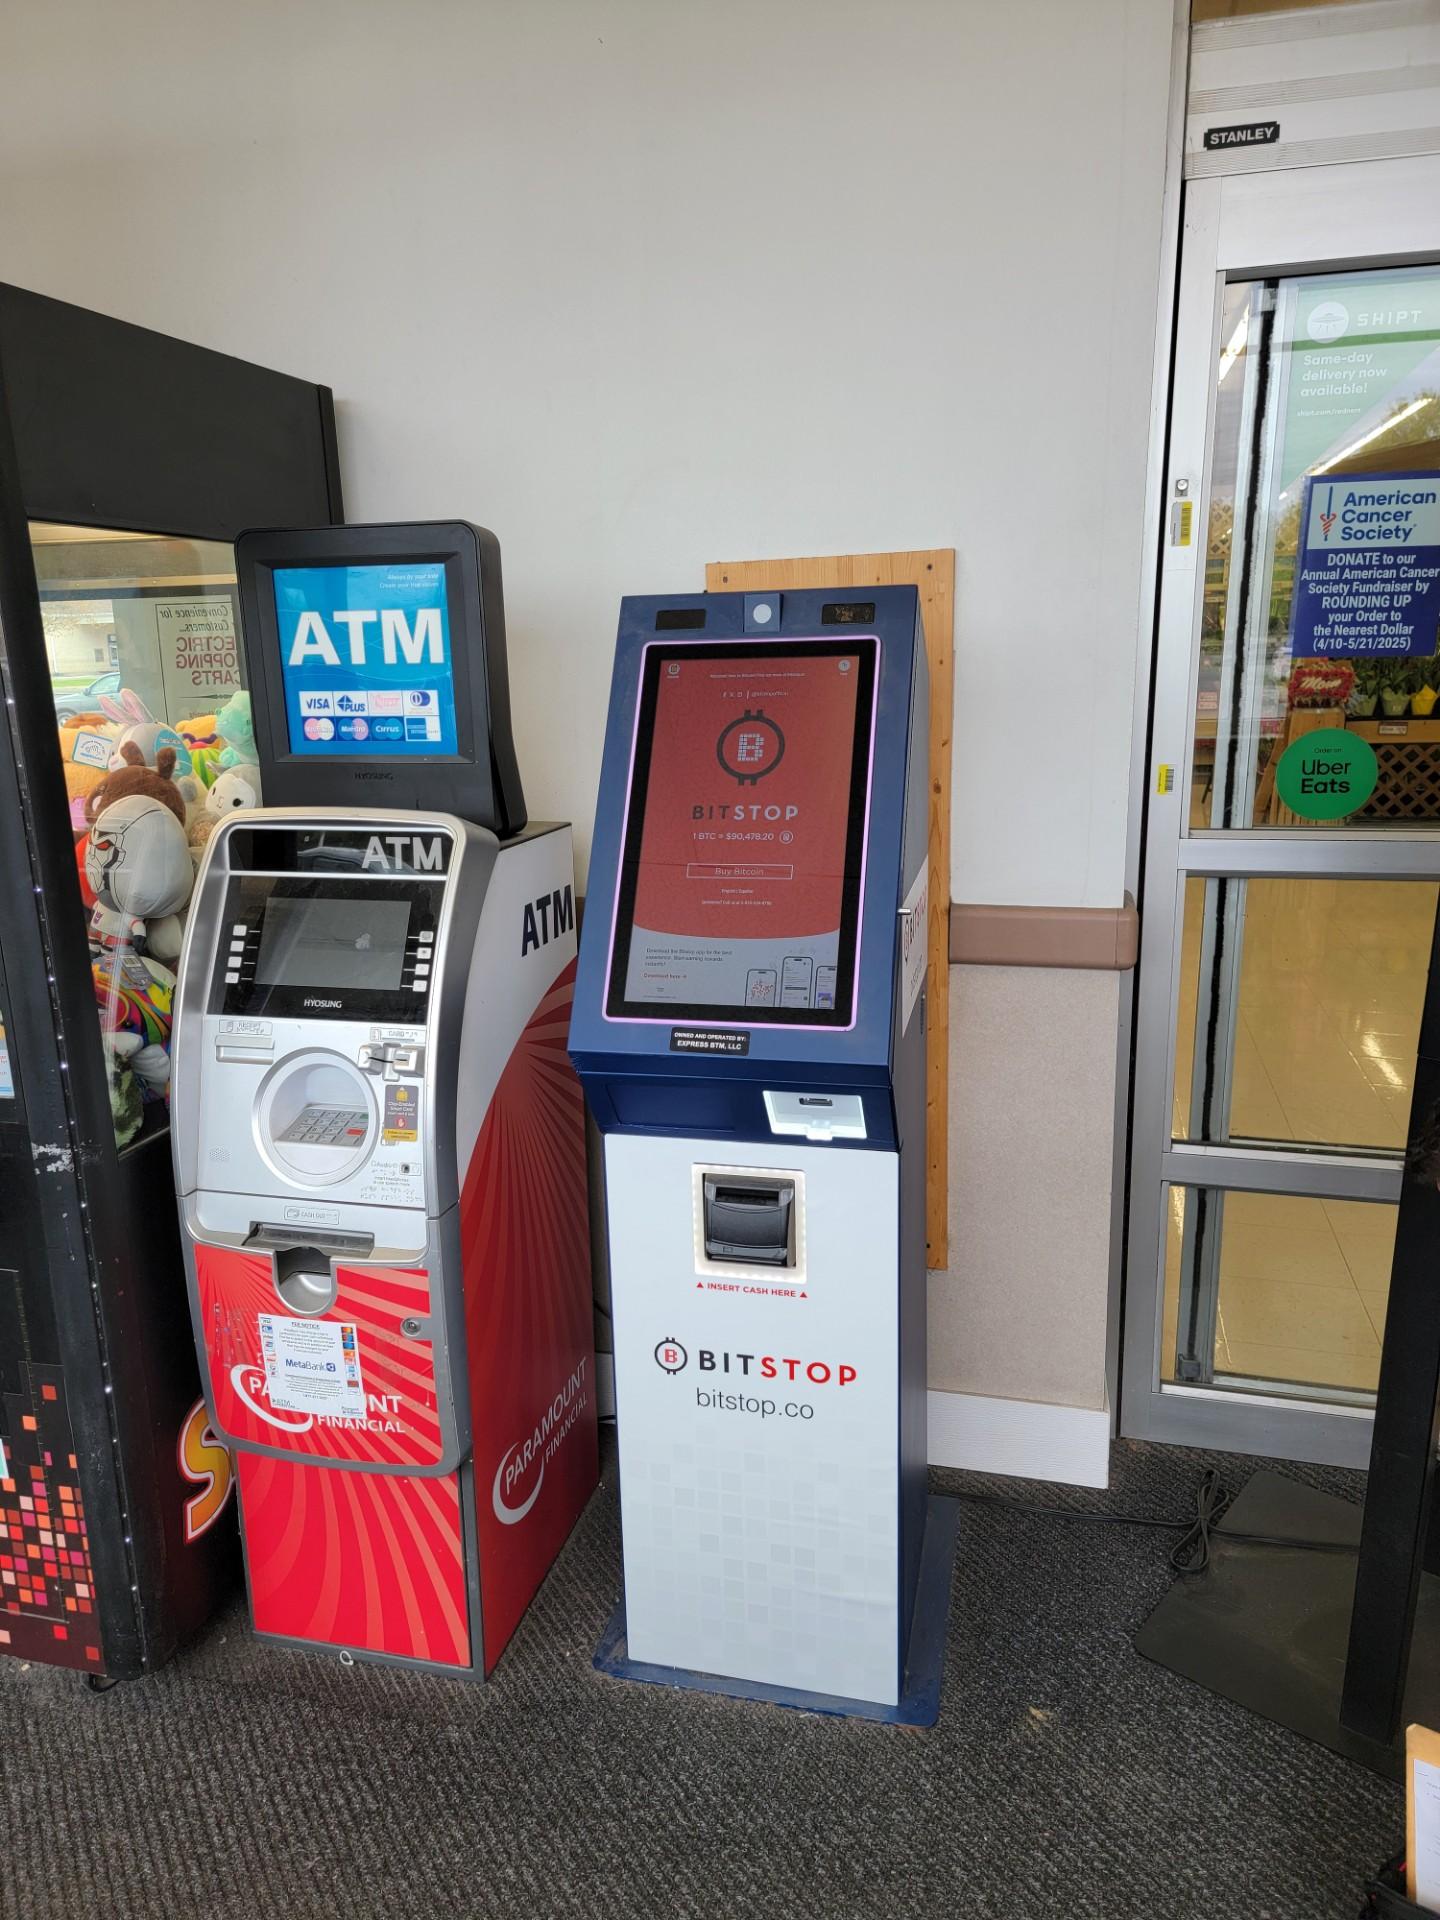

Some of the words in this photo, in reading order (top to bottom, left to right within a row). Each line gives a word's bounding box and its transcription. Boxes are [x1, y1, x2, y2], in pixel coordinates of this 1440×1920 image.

[1209, 126, 1275, 145] STANLEY
[1357, 310, 1422, 327] SHIPT
[1303, 352, 1374, 367] Same-day
[1301, 369, 1357, 381] delivery
[1359, 368, 1388, 378] now
[1300, 383, 1368, 397] available!
[1343, 490, 1437, 507] American
[1341, 509, 1413, 525] Cancer
[1341, 525, 1413, 542] Society
[1327, 552, 1381, 566] DONATE
[1382, 553, 1395, 565] to
[1396, 553, 1417, 565] our
[1301, 567, 1340, 581] Annual
[1341, 566, 1397, 580] American
[1399, 566, 1440, 579] Cancer
[1308, 583, 1350, 596] Society
[1352, 580, 1412, 593] Fundraiser
[1415, 580, 1430, 595] by
[1322, 595, 1390, 608] ROUNDING
[1393, 595, 1412, 608] UP
[1328, 612, 1354, 625] your
[1355, 610, 1389, 622] Order
[1390, 610, 1402, 621] to
[288, 608, 444, 666] ATM
[1313, 625, 1332, 636] the
[1334, 624, 1378, 636] Nearest
[1380, 623, 1414, 635] Dollar
[1313, 637, 1411, 651] (4/10-5/21/2025)
[306, 698, 330, 710] VISA
[345, 703, 366, 712] PLUS
[375, 725, 400, 733] Cirrus
[1301, 759, 1351, 776] Uber
[1300, 778, 1351, 794] Eats
[692, 804, 799, 821] BITSTOP
[698, 832, 716, 840] BTC
[361, 836, 443, 871] ATM
[715, 867, 732, 876] Buy
[734, 867, 764, 875] Bitcoin
[521, 884, 574, 957] ATM
[303, 999, 342, 1009] HYOSUNG
[677, 1039, 709, 1049] EXPRESS
[709, 1041, 727, 1050] BTM,
[728, 1042, 742, 1050] LLC
[707, 1033, 736, 1041] OPERATED
[707, 1282, 740, 1292] INSERT
[743, 1285, 769, 1295] CASH
[771, 1289, 796, 1298] HERE
[285, 1359, 326, 1372] MetaBank
[699, 1349, 857, 1386] BITSTOP
[696, 1387, 814, 1420] bitstop.co
[317, 1414, 406, 1433] FINANCIAL
[505, 1356, 587, 1496] PARAMOUNT
[545, 1391, 588, 1464] FINANCIAL
